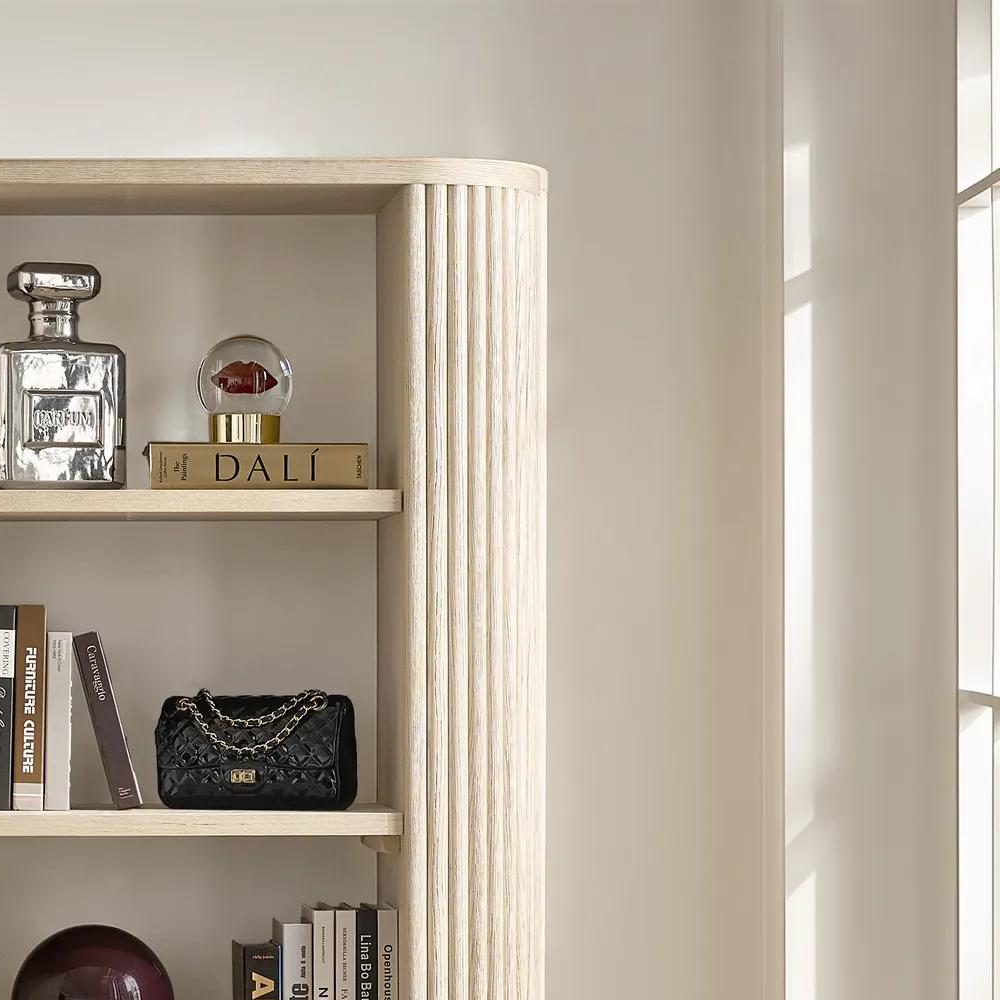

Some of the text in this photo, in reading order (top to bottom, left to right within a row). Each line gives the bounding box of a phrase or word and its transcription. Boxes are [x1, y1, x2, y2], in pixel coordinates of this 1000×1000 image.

[34, 409, 94, 427] PARFUM
[181, 453, 189, 481] Paintings
[215, 448, 320, 482] DALÍ
[2, 631, 10, 675] COVERING
[86, 645, 107, 702] Caravaggio
[22, 647, 38, 774] FURNITURE CULTURE
[360, 934, 372, 960] Lina
[360, 963, 372, 979] Bo
